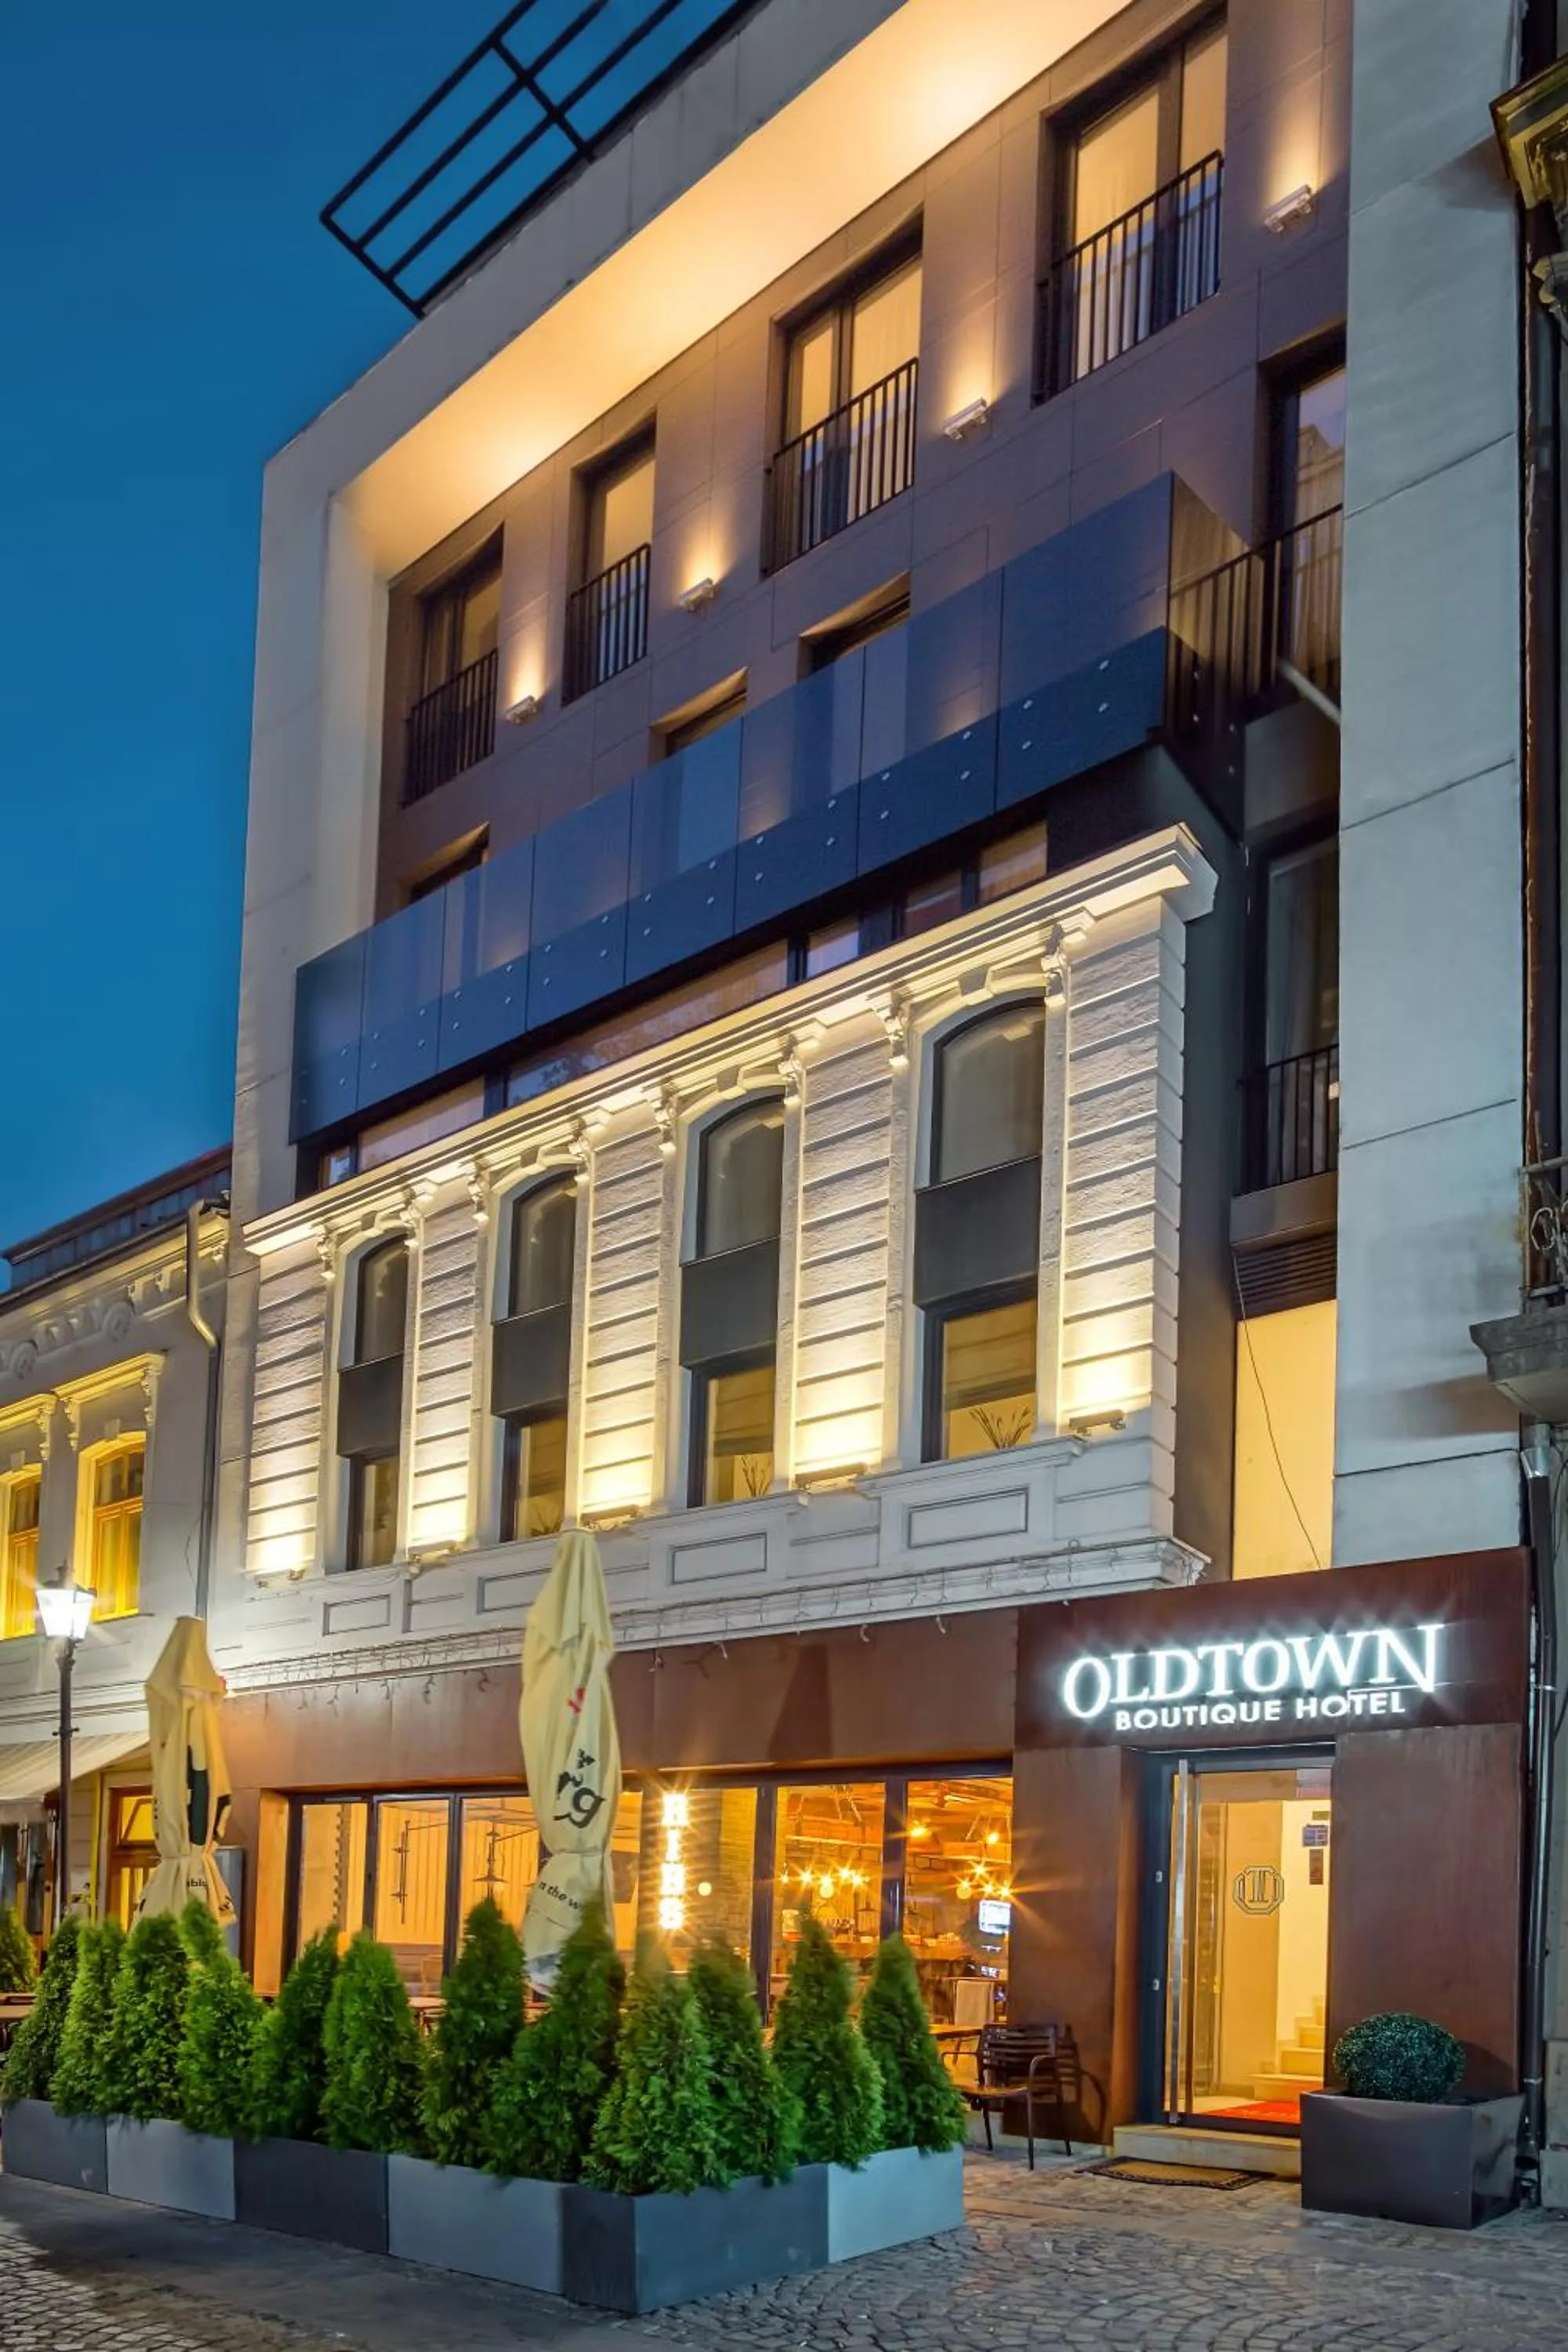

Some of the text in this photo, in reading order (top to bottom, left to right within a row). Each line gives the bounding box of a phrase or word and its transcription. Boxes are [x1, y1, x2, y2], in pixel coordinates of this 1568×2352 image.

[1062, 1624, 1445, 1719] OLDTOWN
[1115, 1690, 1406, 1731] BOUTIQUE HOTEL
